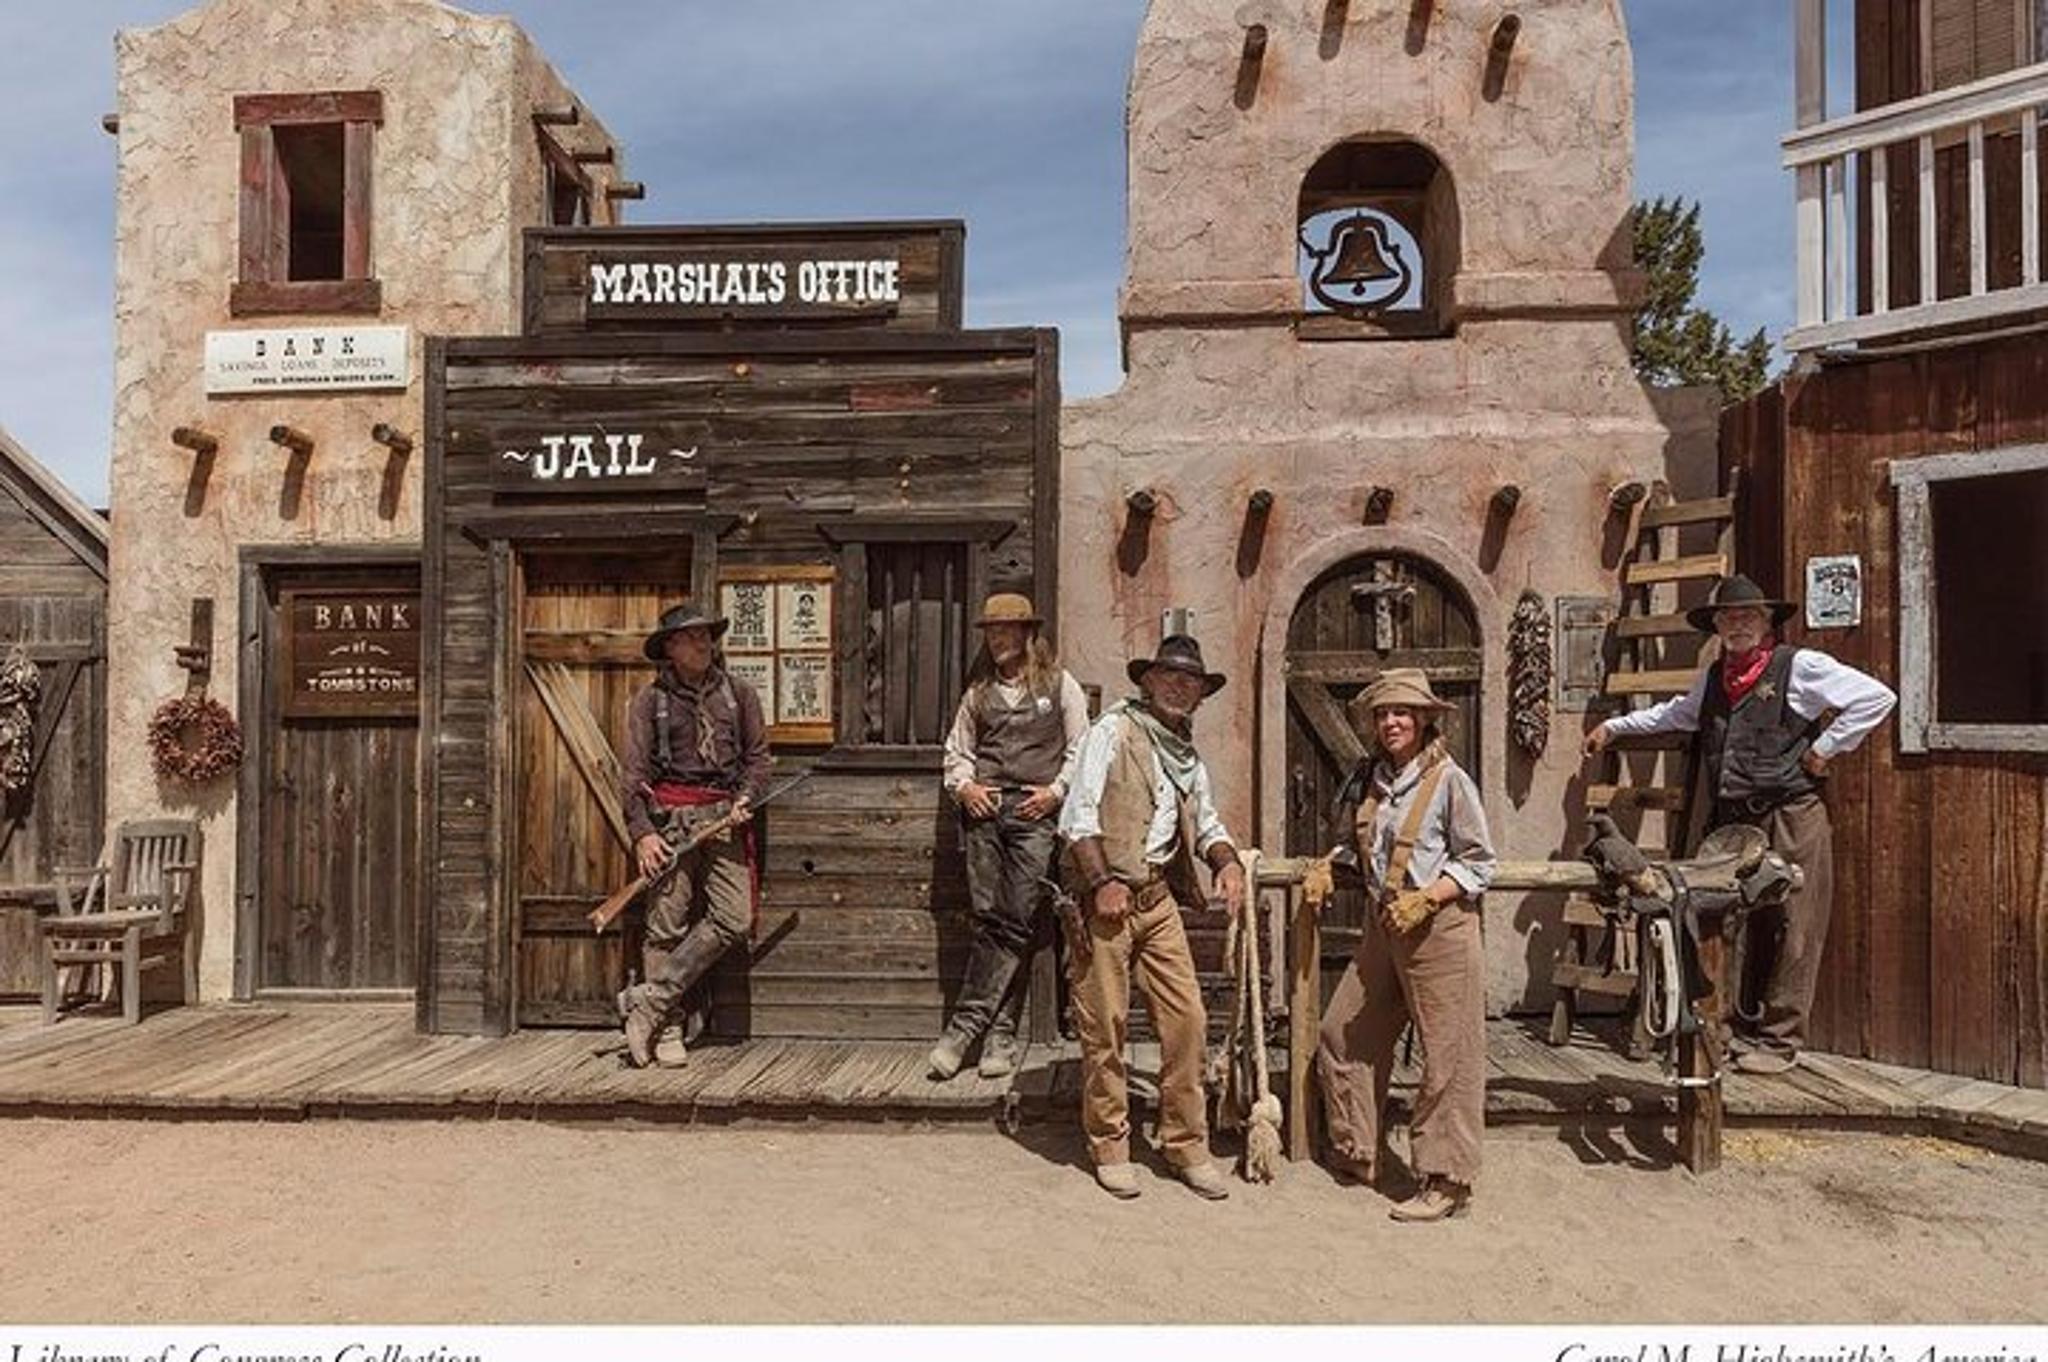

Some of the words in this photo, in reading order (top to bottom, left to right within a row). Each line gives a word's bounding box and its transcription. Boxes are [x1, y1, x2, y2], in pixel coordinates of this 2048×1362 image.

[591, 263, 787, 303] MARSHAL'S
[798, 260, 899, 302] OFFICE
[255, 337, 355, 357] BANK
[532, 434, 657, 479] JAIL
[314, 604, 411, 630] BANK
[307, 677, 416, 692] TOMBSTONE
